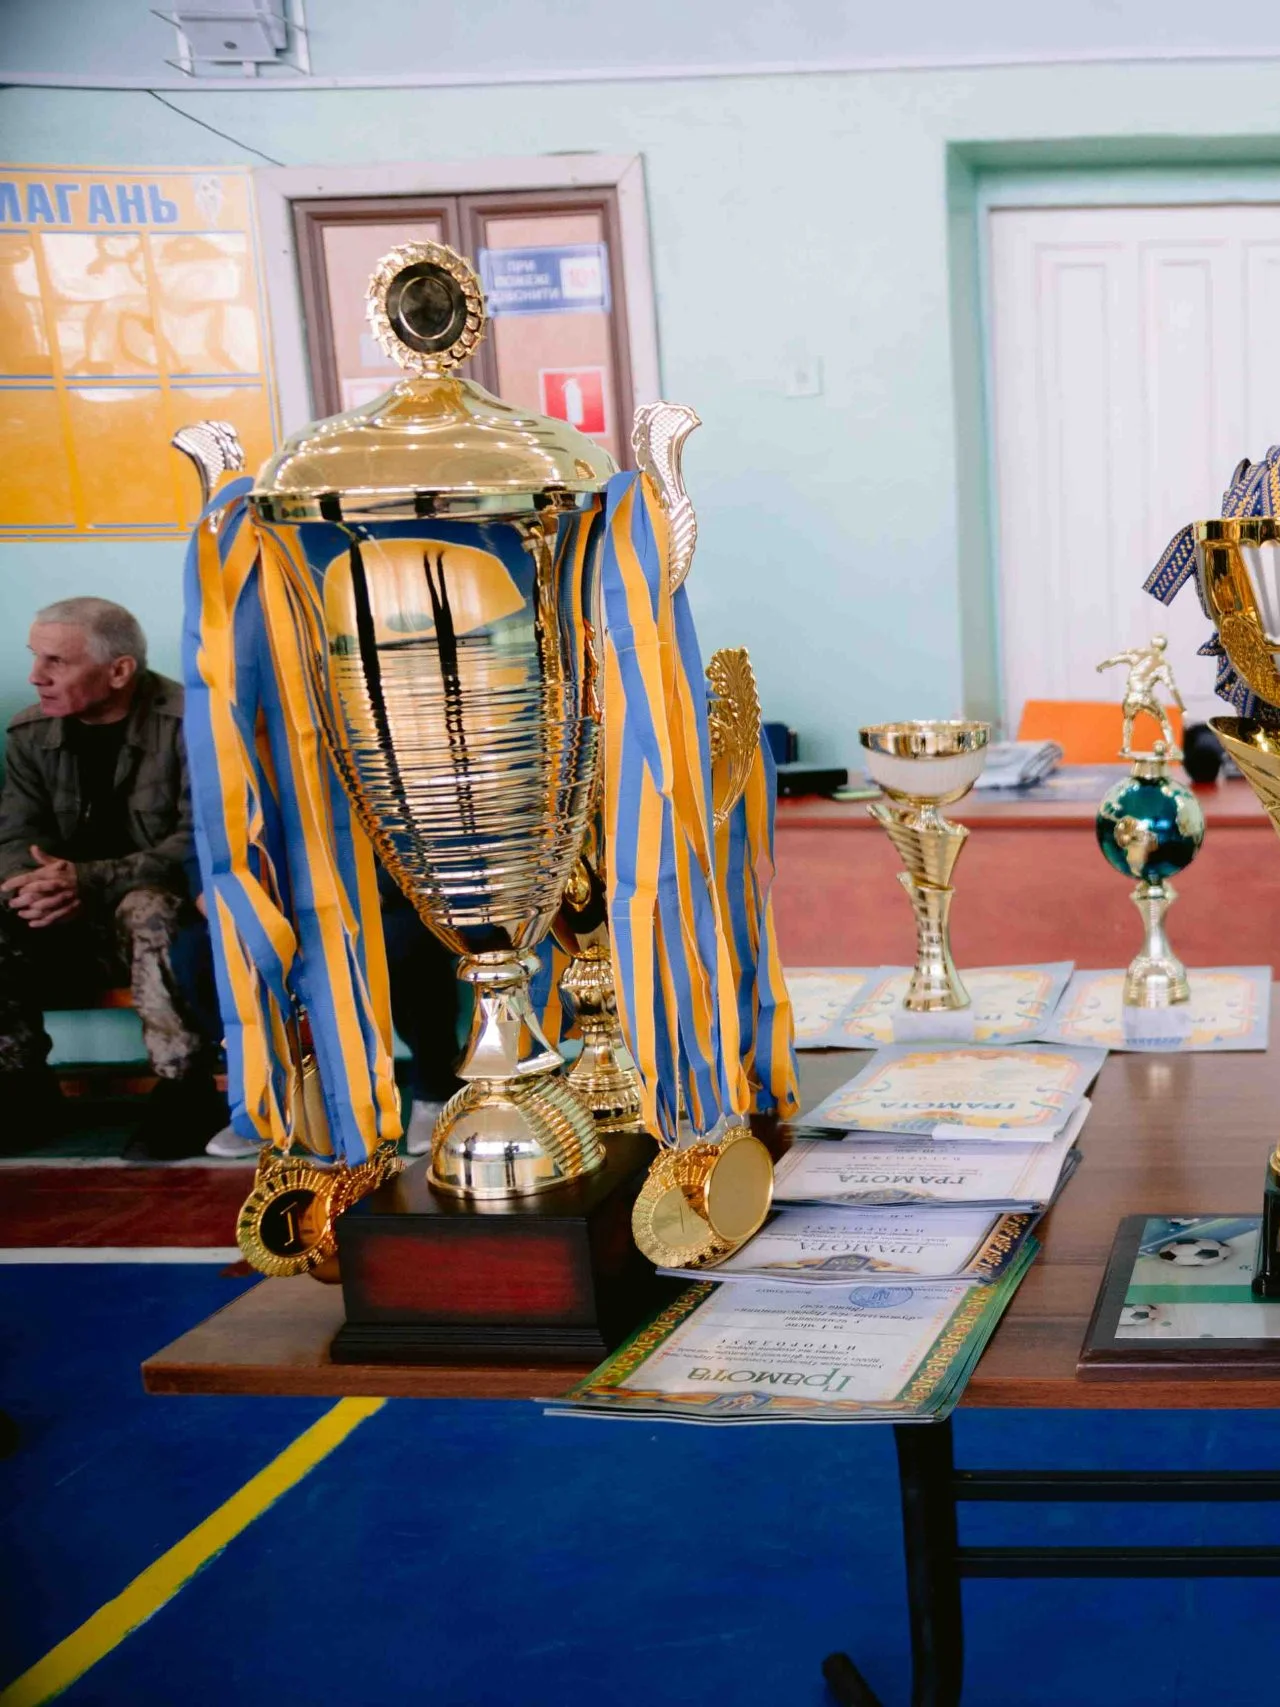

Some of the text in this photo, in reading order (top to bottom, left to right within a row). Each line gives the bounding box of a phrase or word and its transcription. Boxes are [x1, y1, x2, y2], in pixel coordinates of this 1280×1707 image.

[879, 1102, 1017, 1110] ГРАМОТА
[836, 1174, 966, 1185] ГРАМОТА
[798, 1242, 925, 1255] ГРАМОТА
[686, 1367, 856, 1393] Грамота
